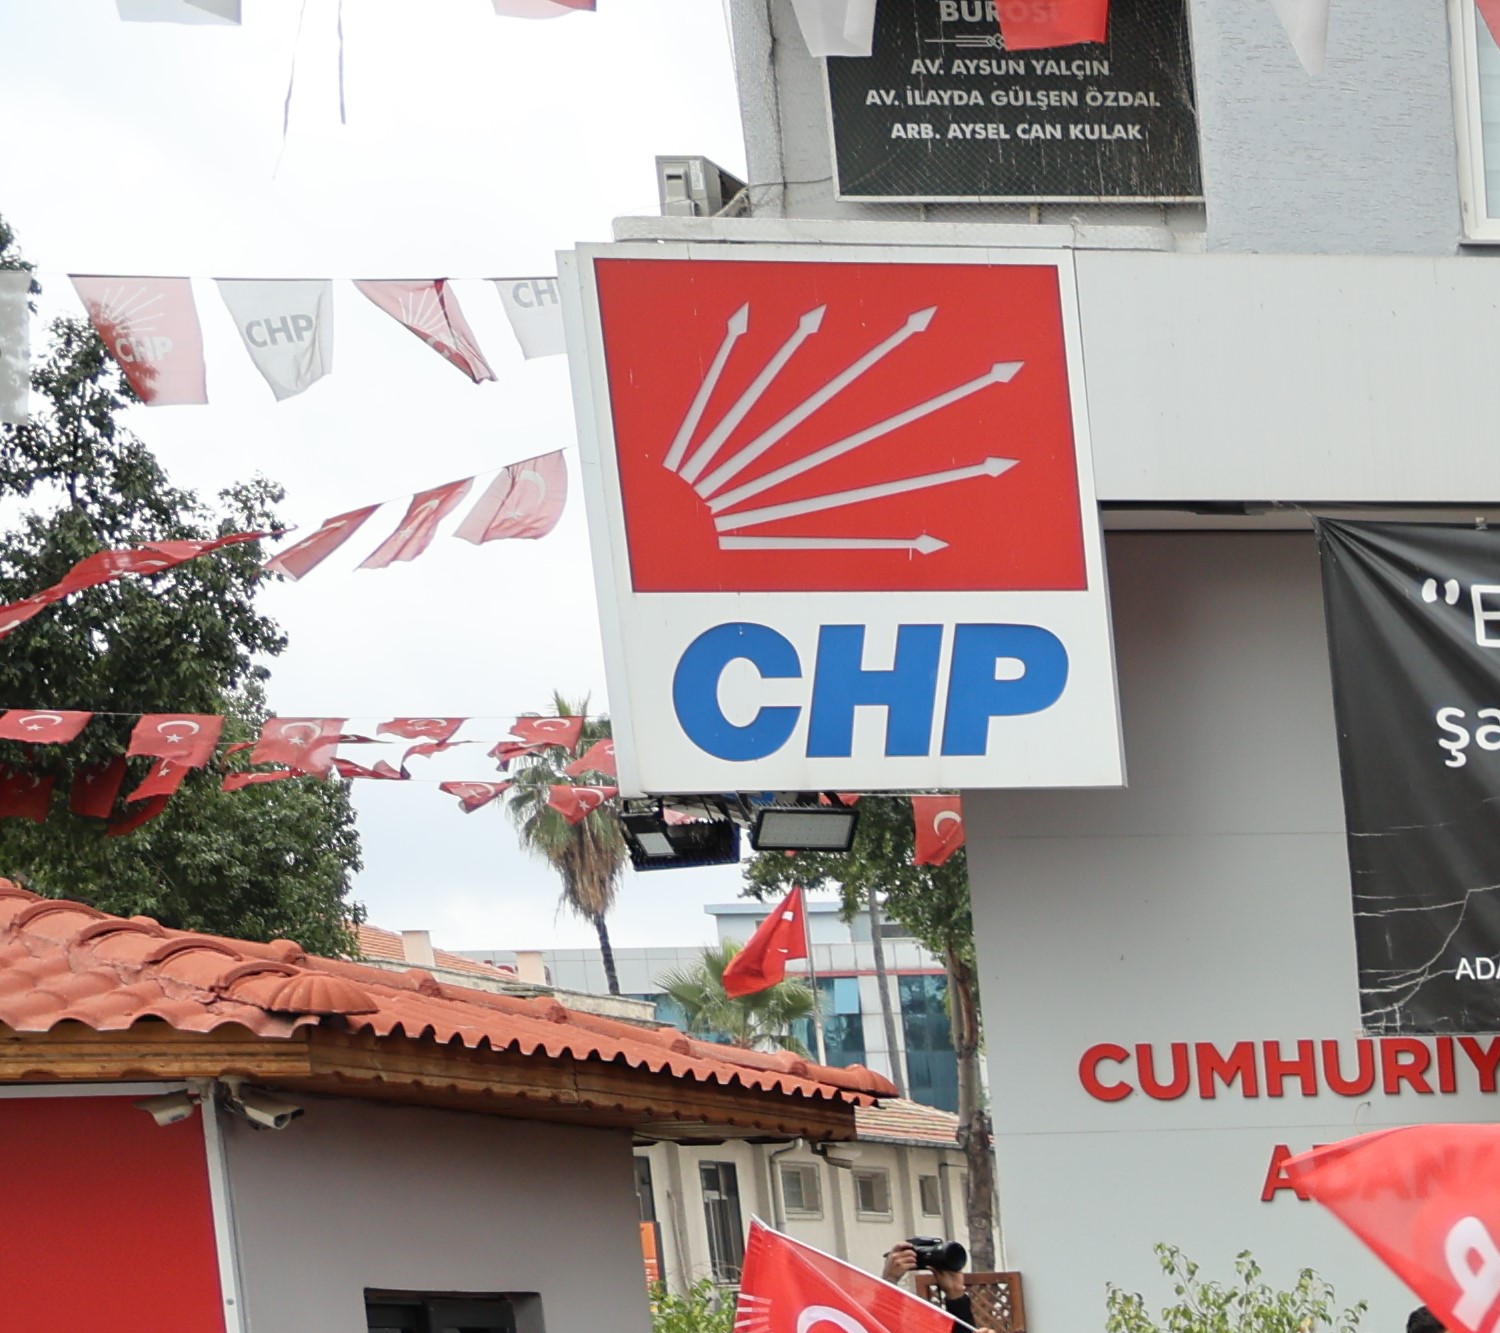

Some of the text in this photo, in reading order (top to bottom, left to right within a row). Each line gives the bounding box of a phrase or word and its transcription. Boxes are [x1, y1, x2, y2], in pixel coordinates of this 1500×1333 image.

[911, 59, 1110, 80] AV. AYSUN YALÇIN
[865, 85, 1161, 110] AV. İLAYDA GÜLŞEN ÖZDAL
[891, 122, 1143, 140] ARB. AYSEL CAN KULAK
[512, 280, 558, 309] CH
[244, 313, 314, 349] CHP
[115, 335, 173, 364] CHP
[672, 620, 1070, 762] CHP
